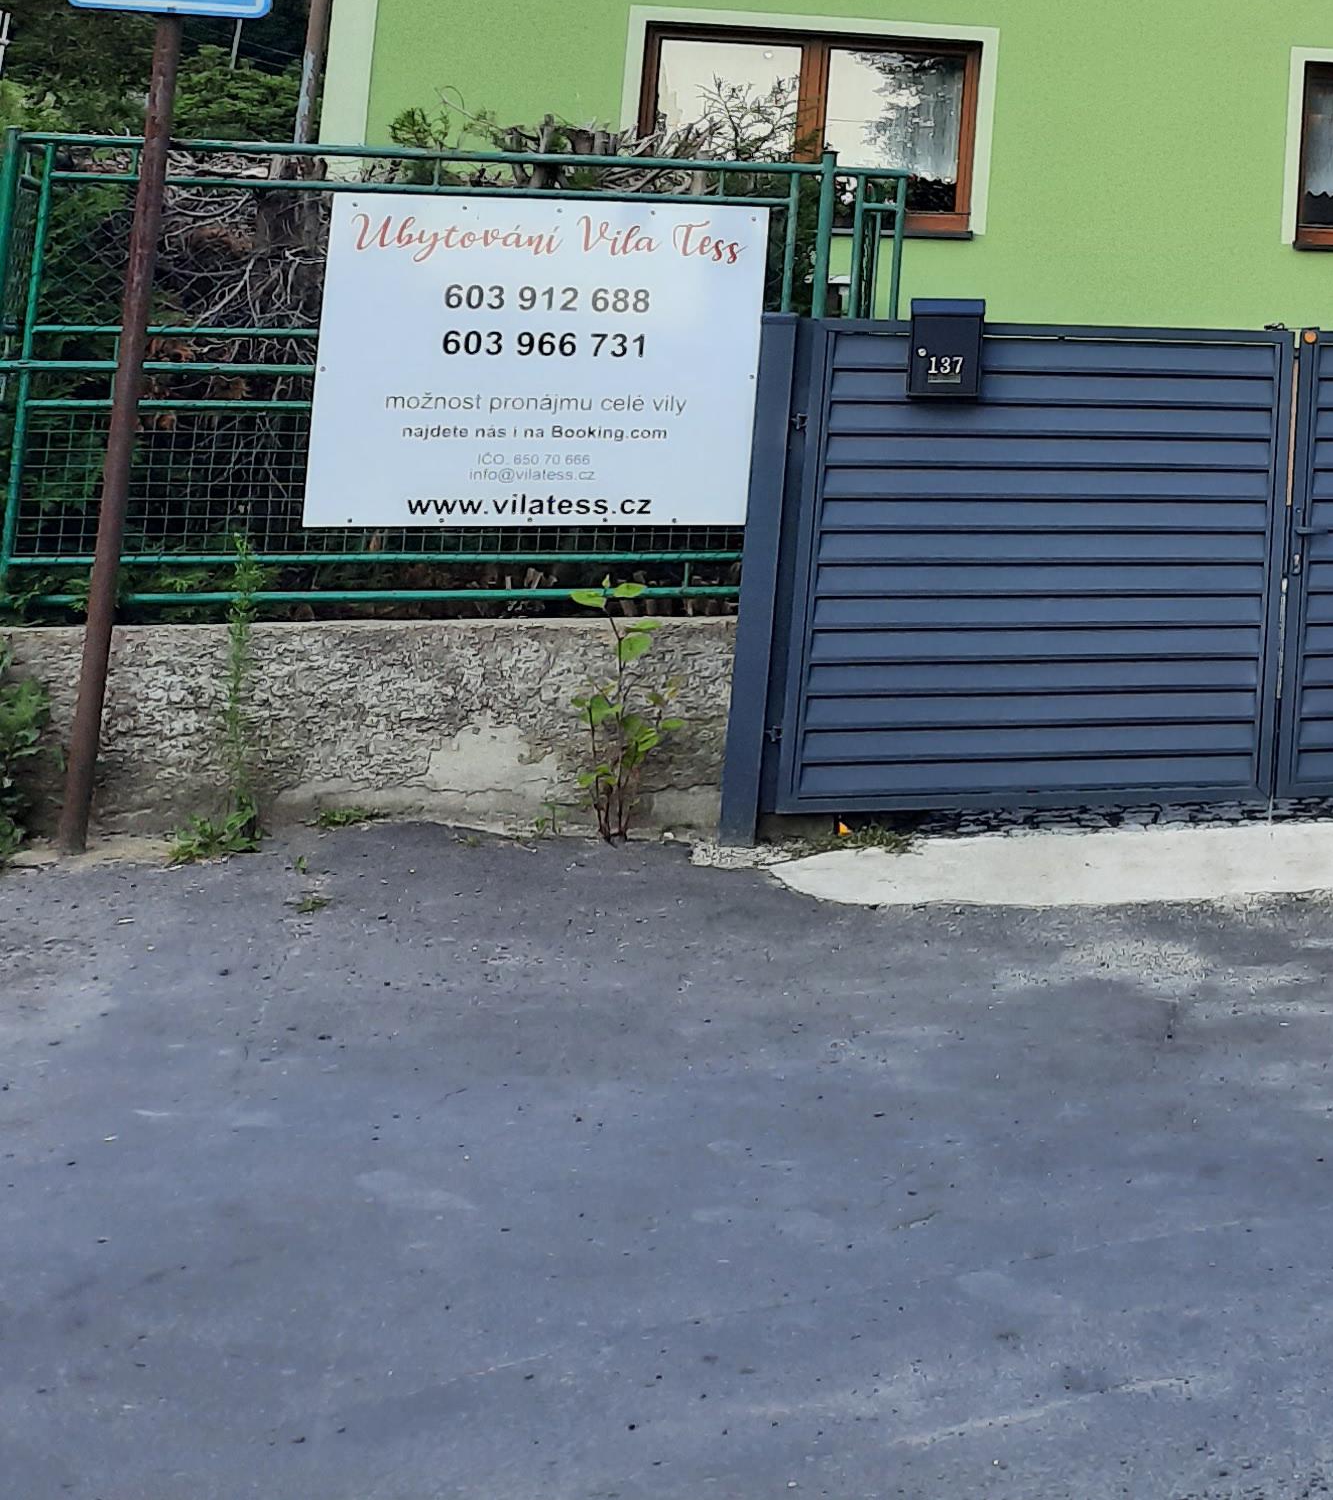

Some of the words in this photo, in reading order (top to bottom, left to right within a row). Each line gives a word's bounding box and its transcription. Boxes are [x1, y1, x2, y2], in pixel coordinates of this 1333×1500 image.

[350, 212, 565, 263] Ubytování
[575, 215, 662, 257] Vila
[672, 220, 750, 265] Tess
[443, 283, 505, 311] 603
[517, 285, 579, 312] 912
[590, 287, 650, 314] 688
[441, 330, 503, 356] 603
[515, 332, 577, 358] 966
[590, 333, 646, 358] 731
[927, 356, 964, 374] 137
[385, 391, 482, 411] možnost
[488, 394, 593, 414] pronájmu
[600, 394, 645, 412] celé
[652, 395, 687, 415] vily
[402, 425, 469, 440] najdete
[475, 425, 507, 439] nás
[513, 426, 517, 438] i
[524, 429, 545, 439] na
[551, 426, 668, 441] Booking.com
[544, 454, 561, 466] 70
[469, 467, 596, 484] info@vilatess.cz
[407, 494, 652, 516] www.vilatess.cz
